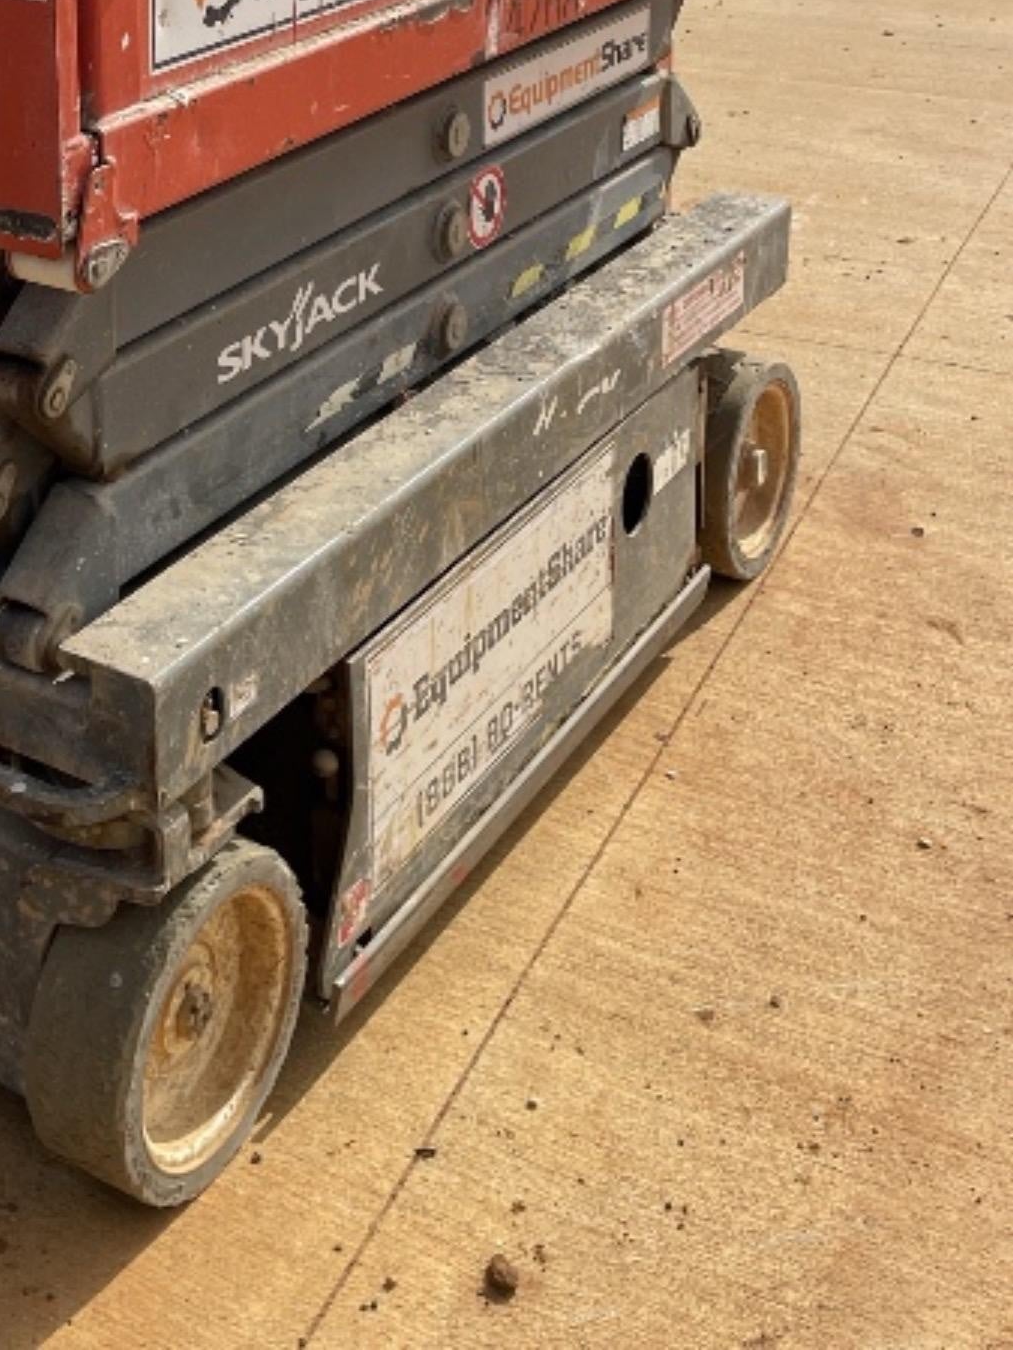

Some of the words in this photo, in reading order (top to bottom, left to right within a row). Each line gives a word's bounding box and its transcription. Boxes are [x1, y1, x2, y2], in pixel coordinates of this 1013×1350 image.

[509, 32, 647, 115] EquipmentShare
[217, 262, 384, 384] SKYJACK
[412, 514, 610, 721] EquipmentShare
